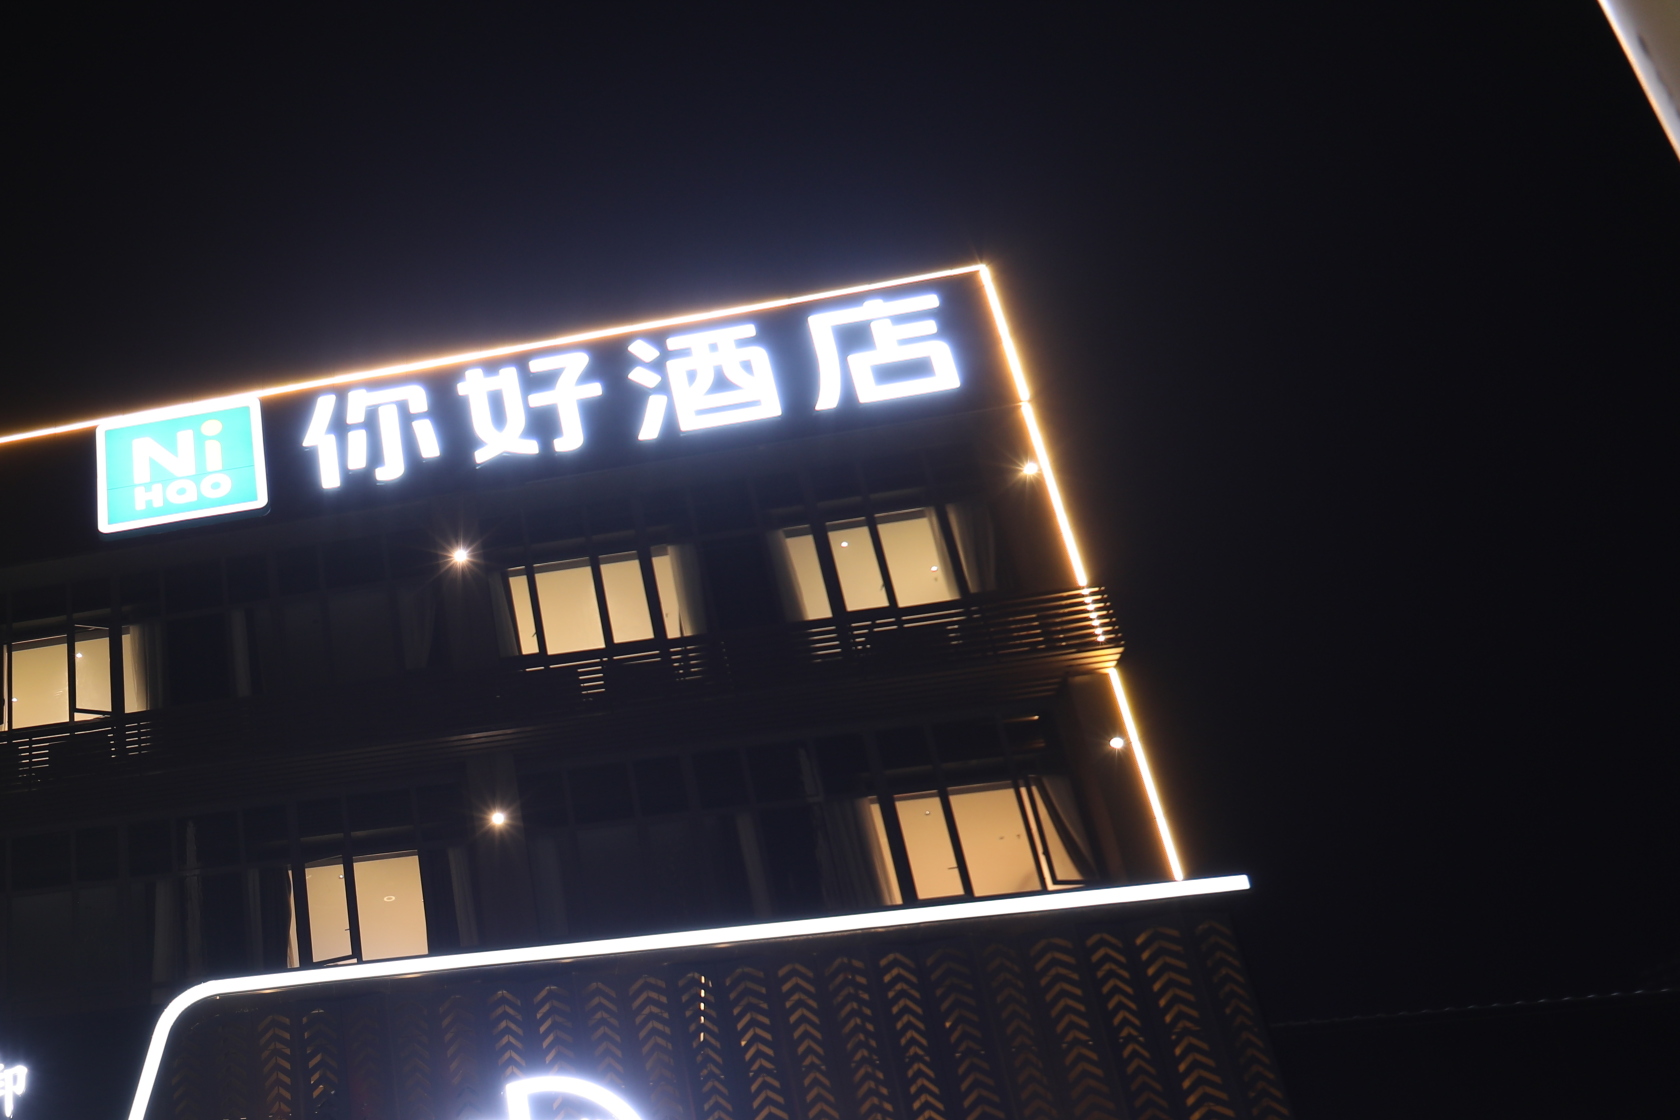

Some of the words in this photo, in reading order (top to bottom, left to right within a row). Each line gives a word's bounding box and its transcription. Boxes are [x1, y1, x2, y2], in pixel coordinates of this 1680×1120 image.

[132, 419, 223, 484] Ni
[302, 293, 961, 489] 你好酒店
